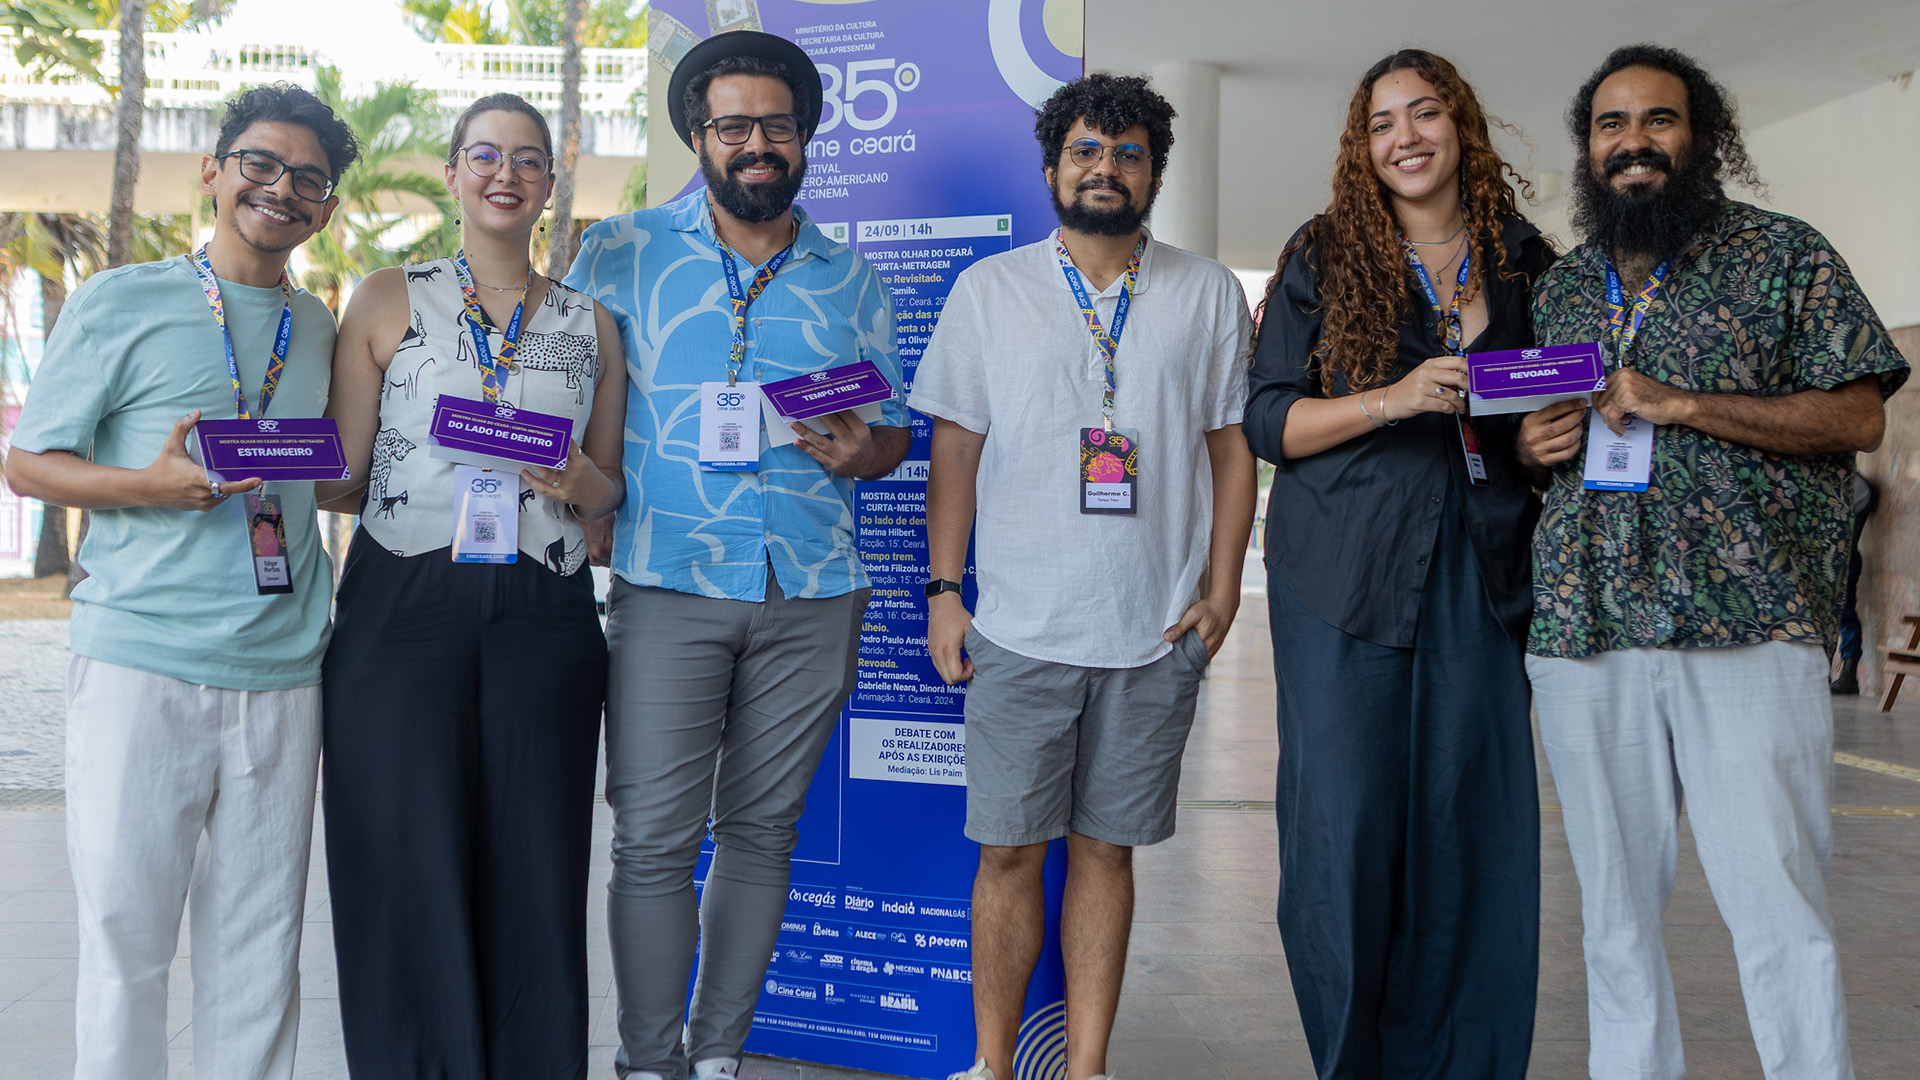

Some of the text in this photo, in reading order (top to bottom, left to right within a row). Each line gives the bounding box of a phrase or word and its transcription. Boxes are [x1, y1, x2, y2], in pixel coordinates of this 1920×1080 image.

[795, 20, 877, 35] MINISTÉRIO DA CULTURA
[800, 35, 842, 46] SECRETARIA
[842, 34, 853, 42] DA
[853, 31, 885, 41] CULTURA
[805, 43, 876, 56] CEARÁ APRESENTAM
[805, 129, 916, 159] ine ceará
[805, 163, 841, 175] STIVAL
[801, 172, 889, 188] ERO-AMERICANO
[808, 187, 850, 200] CINEMA
[865, 223, 933, 238] 24/09 14h
[864, 246, 974, 261] MOSTRA OLHAR DO CEARÁ
[724, 259, 734, 274] cine
[893, 273, 945, 285] Revisitado.
[908, 296, 934, 307] Ceará.
[1077, 291, 1088, 307] cine
[1117, 297, 1128, 315] cine
[915, 309, 932, 320] das
[474, 328, 484, 343] cine
[276, 339, 287, 356] cine
[1509, 368, 1559, 380] REVOADA
[801, 383, 861, 402] TEMPO TREM
[447, 420, 553, 448] DO LADO DE DENTRO
[237, 447, 313, 457] ESTRANGEIRO
[906, 466, 929, 478] 14h
[860, 492, 926, 502] MOSTRA OLHAR
[866, 504, 926, 513] CURTA-METRA
[860, 515, 873, 525] Do
[874, 515, 894, 525] lado
[895, 515, 907, 525] de
[860, 528, 917, 537] Marina Hilbert.
[860, 539, 887, 550] Ficção.
[903, 539, 928, 549] Ceará.
[860, 551, 916, 563] Tempo trem.
[891, 564, 918, 573] Filizola
[871, 588, 912, 599] rangeiro.
[884, 600, 916, 609] Martins.
[901, 611, 925, 621] Ceará.
[882, 635, 905, 644] Paulo
[898, 647, 923, 657] Ceará.
[857, 658, 899, 669] Revoada.
[858, 670, 921, 682] Tuan Fernandes,
[857, 681, 966, 694] Gabrielle Neara, Dinorá Melo
[857, 692, 897, 703] Animação.
[908, 694, 933, 705] Ceará.
[934, 697, 956, 706] 2024.
[894, 727, 956, 740] DEBATE COM
[881, 739, 895, 748] OS
[878, 750, 966, 766] APÓS AS EXIBIÇÕE
[887, 764, 963, 778] Mediação: Lis Paim
[801, 890, 836, 907] cegás
[844, 894, 875, 909] Diário
[881, 900, 915, 915] indaiá
[781, 922, 807, 931] OMINUS
[854, 930, 877, 940] ALECE
[895, 964, 925, 974] MECENAS
[777, 986, 794, 996] Cine
[795, 988, 817, 999] Ceará
[880, 994, 919, 1011] BRASIL
[766, 1017, 777, 1025] TEM
[816, 1025, 836, 1033] CINEMA
[879, 1033, 904, 1043] GOVERNO
[912, 1038, 931, 1046] BRASIL
